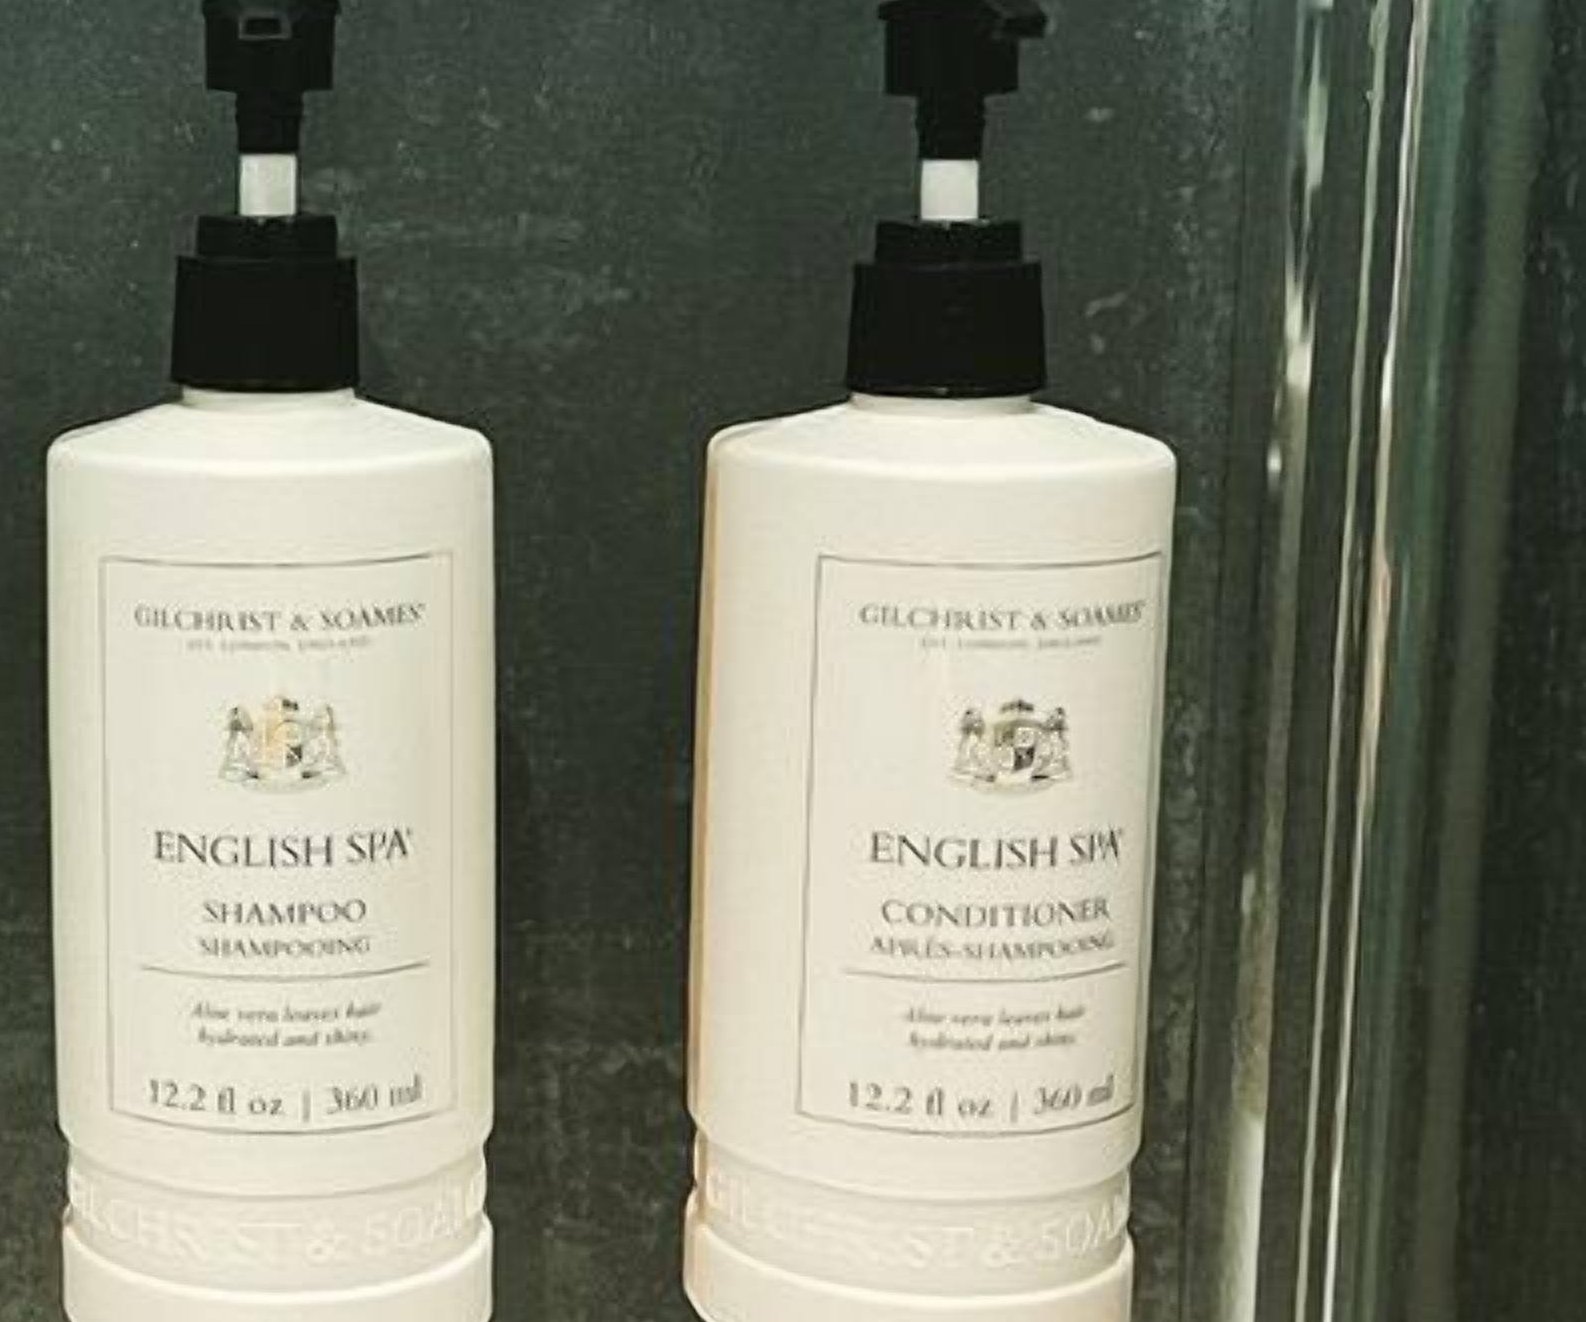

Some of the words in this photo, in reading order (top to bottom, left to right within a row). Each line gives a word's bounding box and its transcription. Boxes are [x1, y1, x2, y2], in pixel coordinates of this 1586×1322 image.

[134, 603, 281, 631] GILCHRIST
[290, 610, 310, 631] &
[859, 602, 1024, 631] GILCHRIST
[1030, 607, 1047, 631] &
[154, 829, 334, 868] ENGLISH
[870, 830, 1059, 869] ENGLISH
[202, 897, 367, 926] SHAMPOO
[880, 896, 1112, 928] CONDITIONER
[199, 936, 371, 959] SHAMPOOING
[282, 1029, 320, 1047] and
[149, 1079, 207, 1112] 12.2
[217, 1086, 235, 1115] fl
[248, 1094, 284, 1116] oz
[325, 1083, 378, 1115] 360
[389, 1072, 423, 1106] ml
[849, 1081, 913, 1114] 12.2
[925, 1087, 945, 1116] fl
[958, 1097, 991, 1118] oz
[984, 1220, 1027, 1270] &
